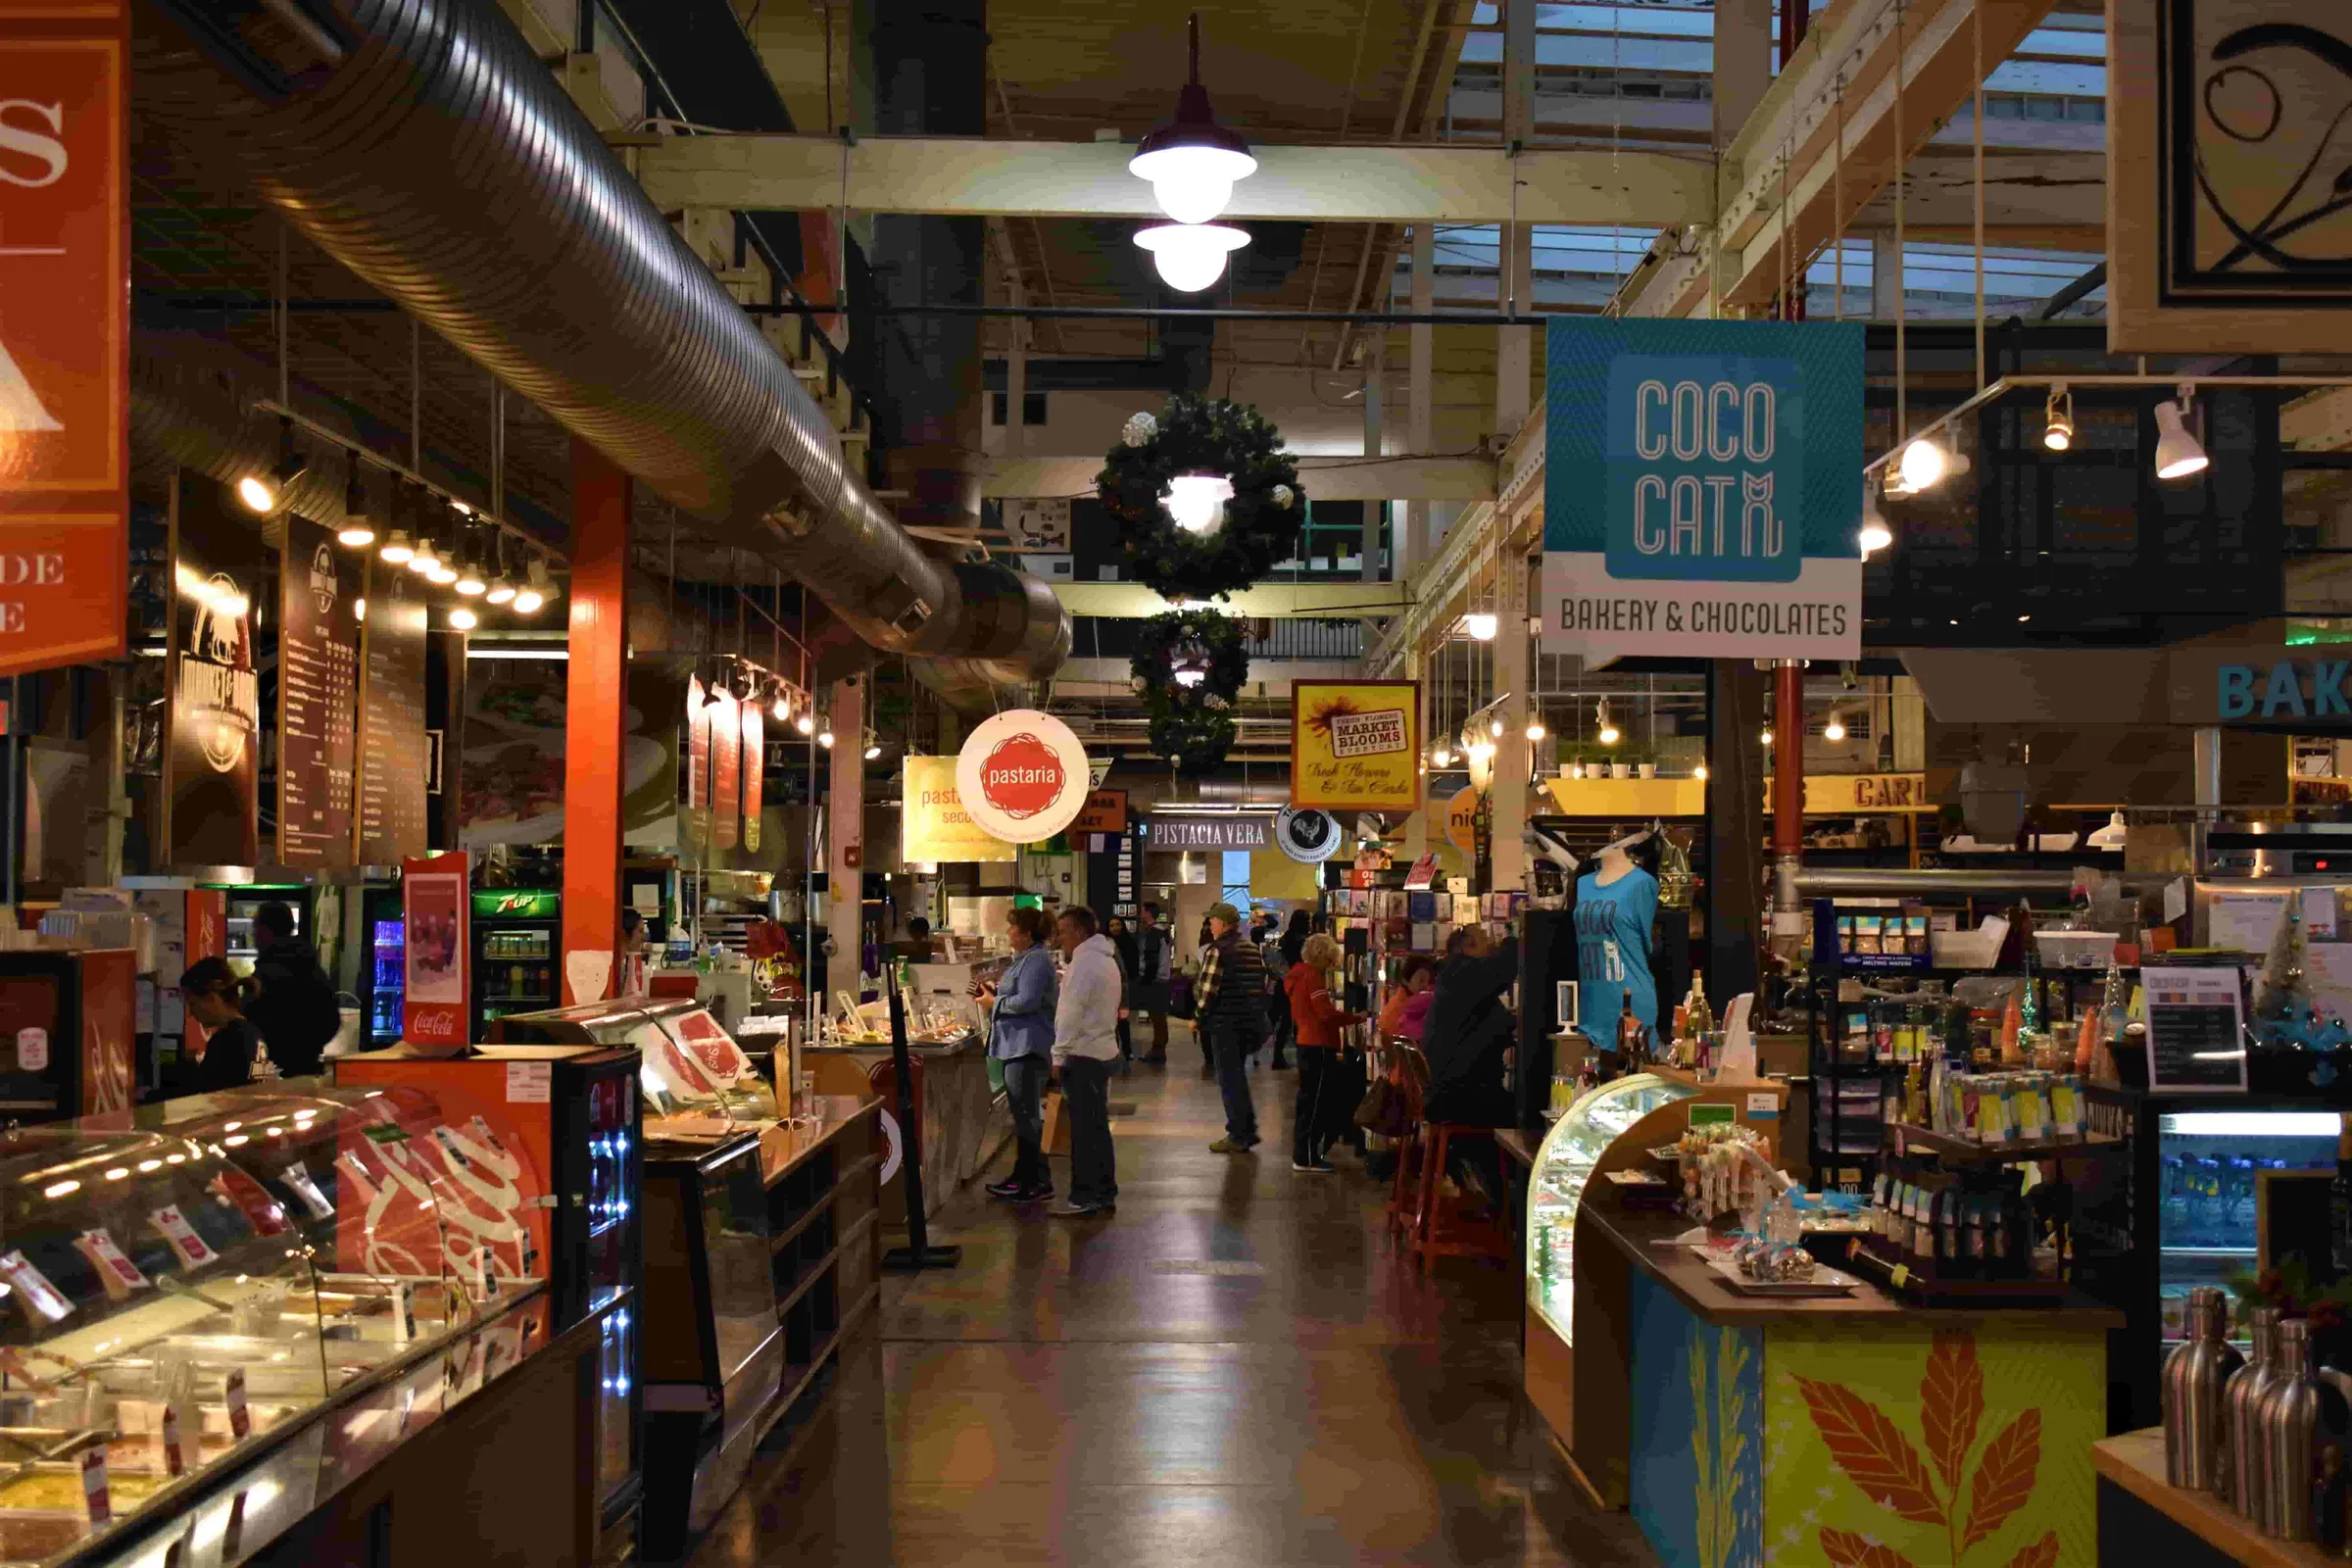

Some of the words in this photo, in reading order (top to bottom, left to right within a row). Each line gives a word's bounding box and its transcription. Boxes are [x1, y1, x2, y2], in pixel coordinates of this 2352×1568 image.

[1636, 380, 1776, 462] COCO
[1561, 598, 1658, 632] BAKERY
[1666, 600, 1685, 632] &
[1691, 601, 1846, 636] CHOCOLATES
[1337, 719, 1399, 737] MARKET
[1339, 731, 1401, 748] BLOOMS
[990, 764, 1056, 788] pastaria
[1152, 823, 1222, 845] PISTACIA
[1227, 823, 1265, 844] VERA
